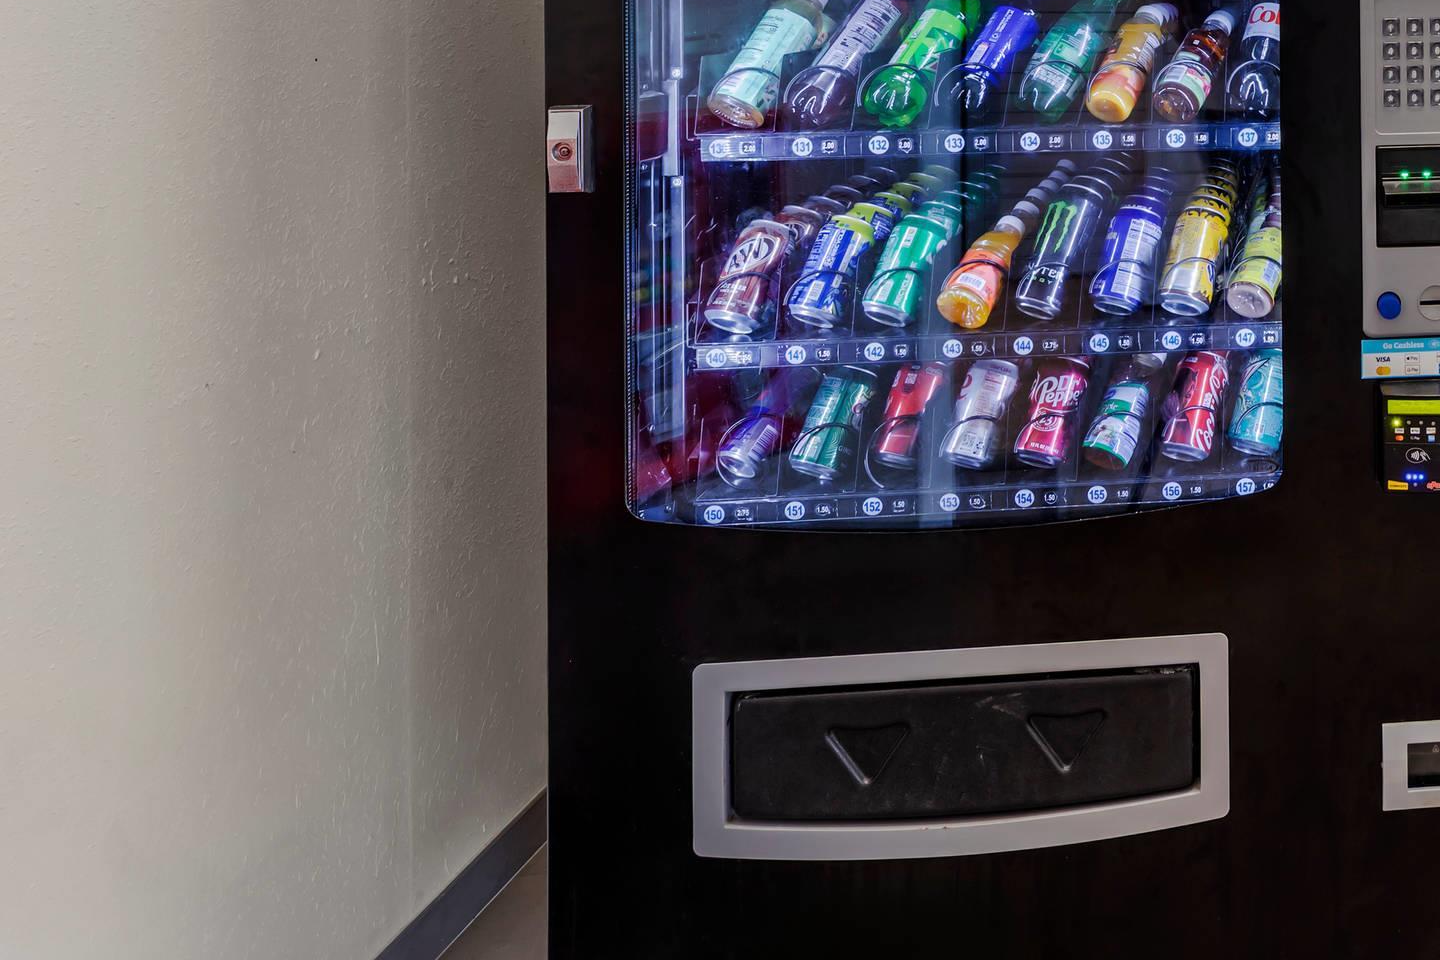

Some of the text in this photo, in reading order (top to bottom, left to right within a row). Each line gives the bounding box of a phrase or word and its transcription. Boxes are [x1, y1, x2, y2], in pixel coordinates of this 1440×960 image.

[1021, 136, 1038, 146] 134
[1095, 135, 1111, 145] 135
[1167, 133, 1183, 143] 136
[1240, 132, 1256, 142] 137
[794, 141, 811, 152] 131
[870, 140, 887, 151] 132
[945, 138, 962, 149] 133
[1091, 337, 1108, 348] 145
[1164, 335, 1180, 345] 146
[1237, 332, 1254, 342] 147
[944, 343, 961, 354] 143
[1015, 340, 1031, 351] 144
[1393, 341, 1425, 349] Cashless
[787, 349, 804, 360] 141
[865, 346, 883, 357] 142
[708, 352, 725, 363] 140
[1163, 486, 1180, 496] 156
[1237, 482, 1254, 493] 157
[1016, 493, 1033, 503] 154
[1089, 490, 1105, 500] 155
[864, 501, 881, 512] 152
[941, 497, 958, 507] 153
[705, 509, 723, 520] 150
[786, 505, 803, 516] 151
